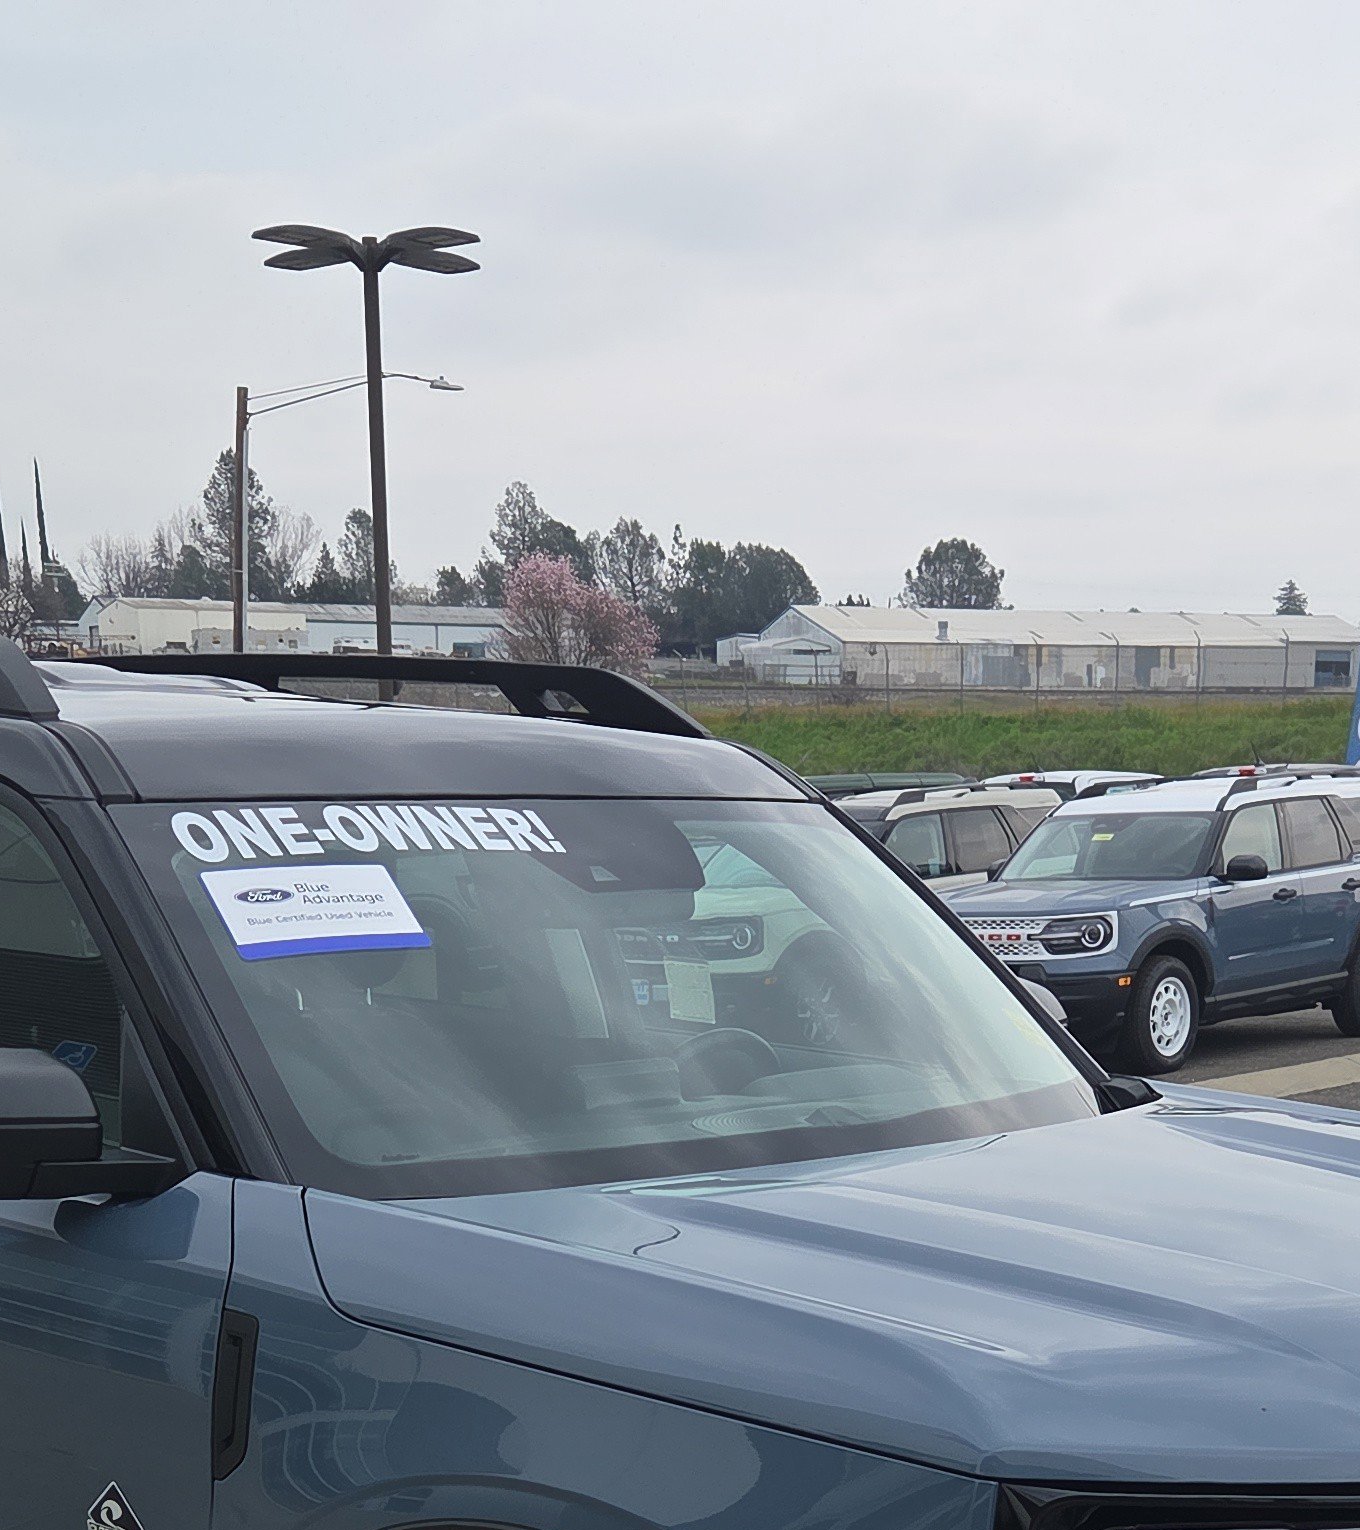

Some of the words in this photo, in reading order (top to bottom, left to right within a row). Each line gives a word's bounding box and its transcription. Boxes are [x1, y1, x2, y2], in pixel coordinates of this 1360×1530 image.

[170, 804, 567, 864] ONE-OWNER!
[294, 883, 331, 893] Blue
[246, 889, 283, 902] Ford
[302, 892, 385, 905] Advantage
[246, 917, 273, 926] Blue
[276, 913, 323, 924] Certified
[324, 911, 353, 921] Used
[354, 909, 394, 919] Vehicle
